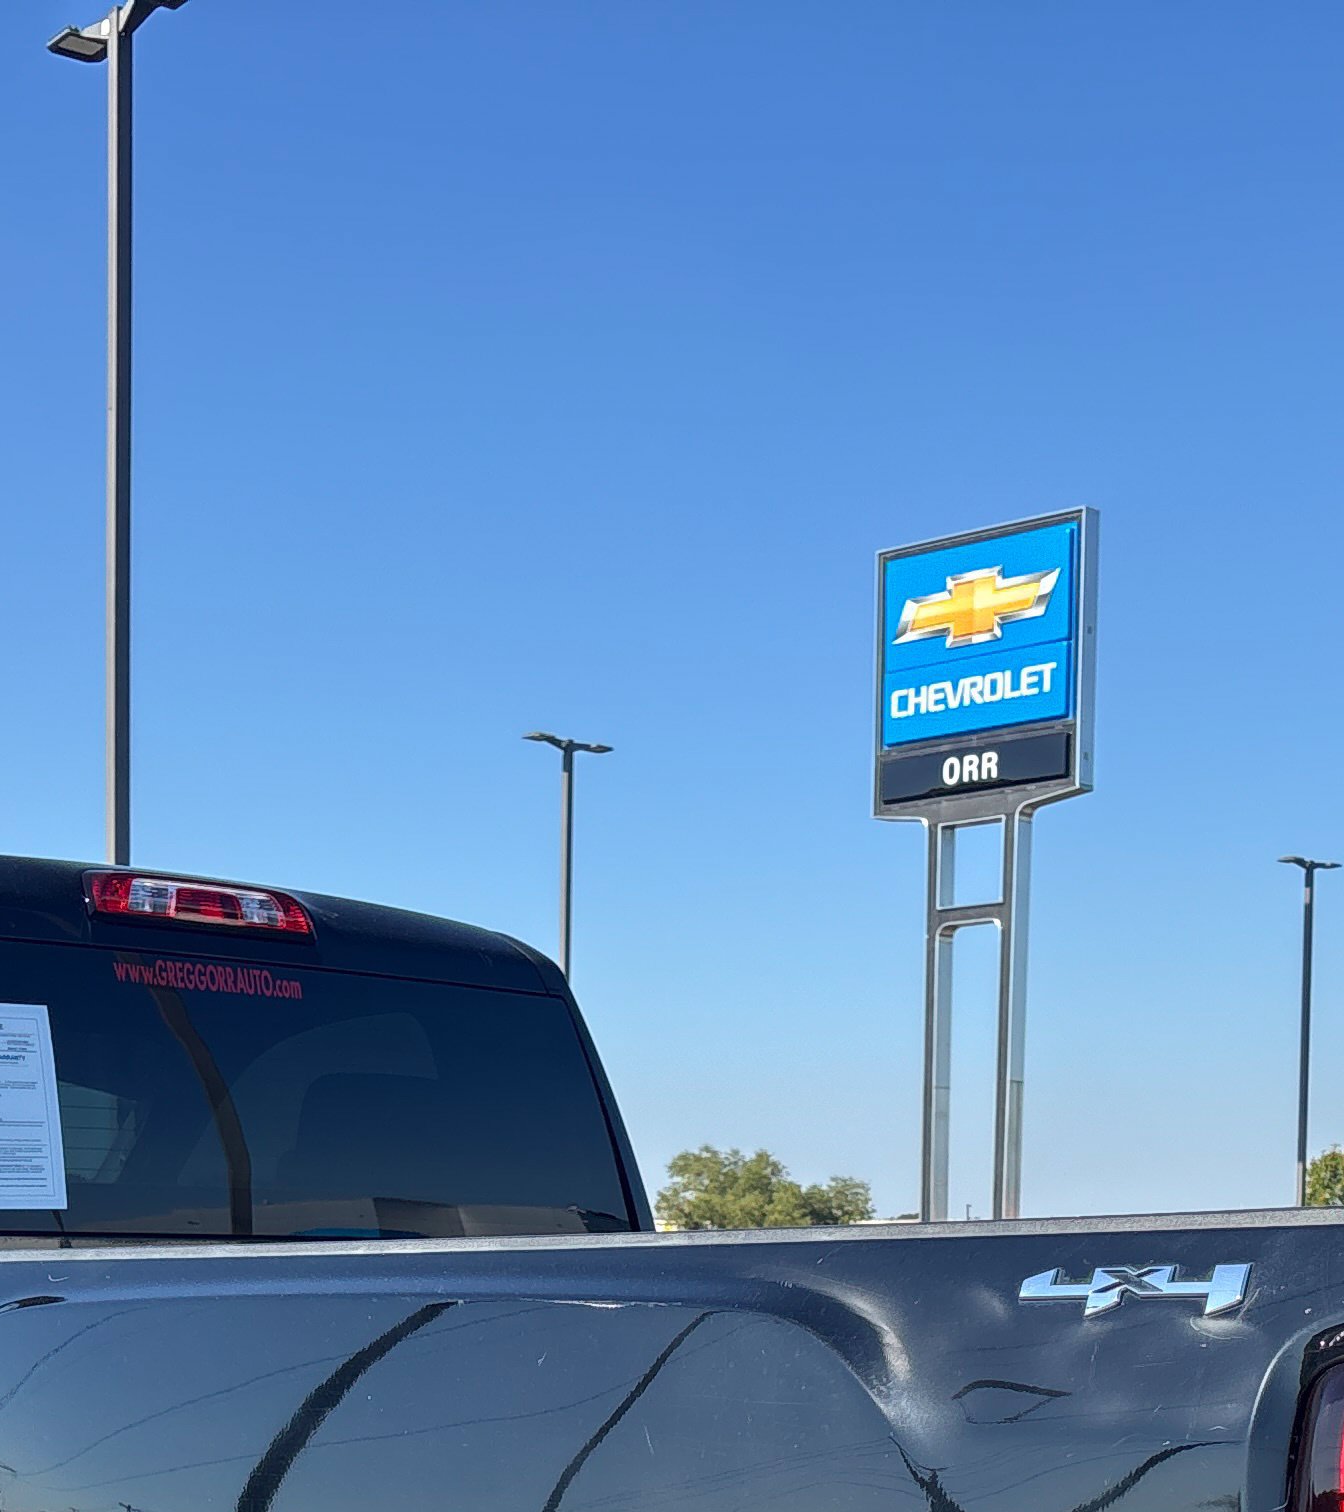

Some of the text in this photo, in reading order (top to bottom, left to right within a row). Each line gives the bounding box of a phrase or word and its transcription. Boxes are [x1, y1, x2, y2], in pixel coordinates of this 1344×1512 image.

[890, 662, 1057, 719] CHEVROLET
[942, 751, 999, 785] ORR
[113, 960, 303, 1000] www.GREGGORRAUTO.com
